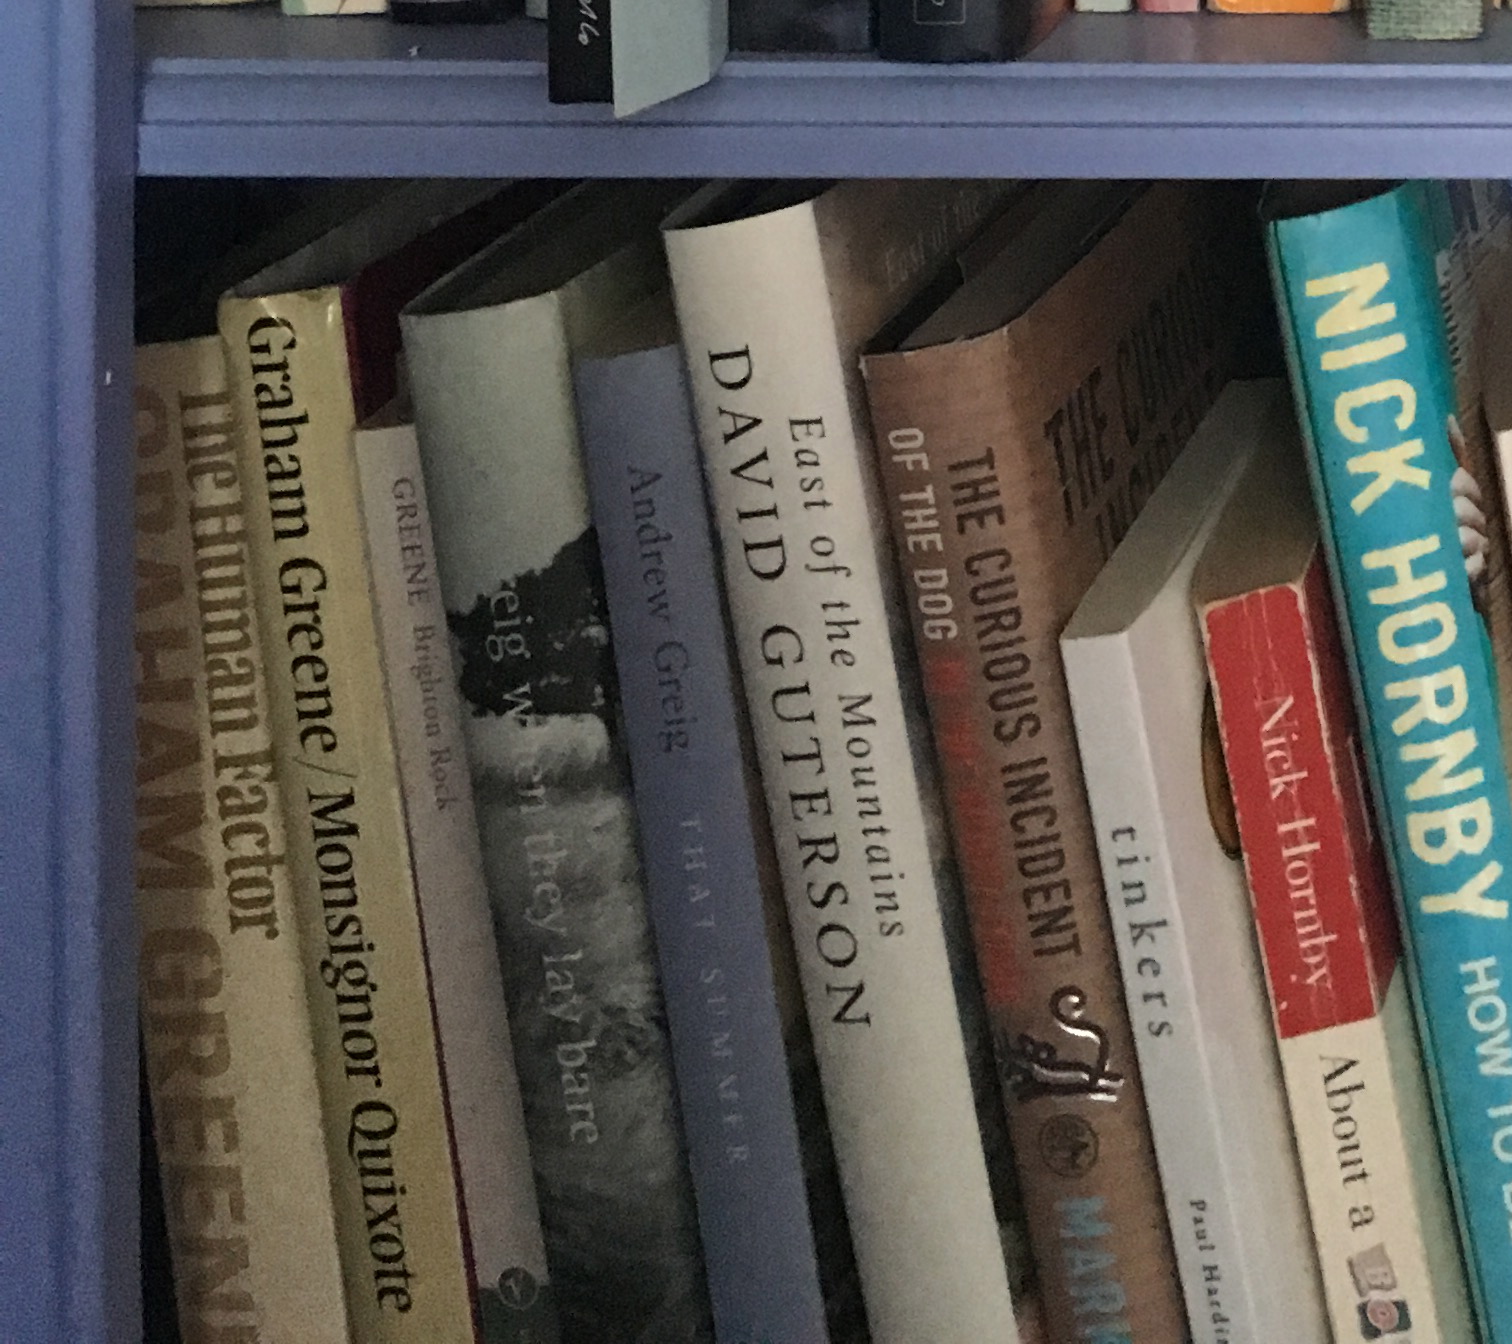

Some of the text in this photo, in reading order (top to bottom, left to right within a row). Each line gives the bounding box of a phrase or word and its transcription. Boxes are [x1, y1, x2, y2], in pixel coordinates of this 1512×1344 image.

[885, 426, 959, 640] OF THE DOG
[945, 446, 1006, 537] THE
[1304, 261, 1432, 516] NICK
[626, 462, 699, 754] Andrew Greig
[706, 344, 871, 1029] DAVID GUTERSON
[786, 414, 906, 939] East of the Mountains
[961, 548, 1044, 744] CURIOUS
[1359, 534, 1509, 921] HORNBY
[245, 316, 416, 1315] Graham Greene Monsignor Quixote
[1000, 756, 1084, 960] INCIDENT
[1251, 694, 1380, 1232] Nick Hornby About a
[1111, 825, 1216, 1253] tinkers Paul
